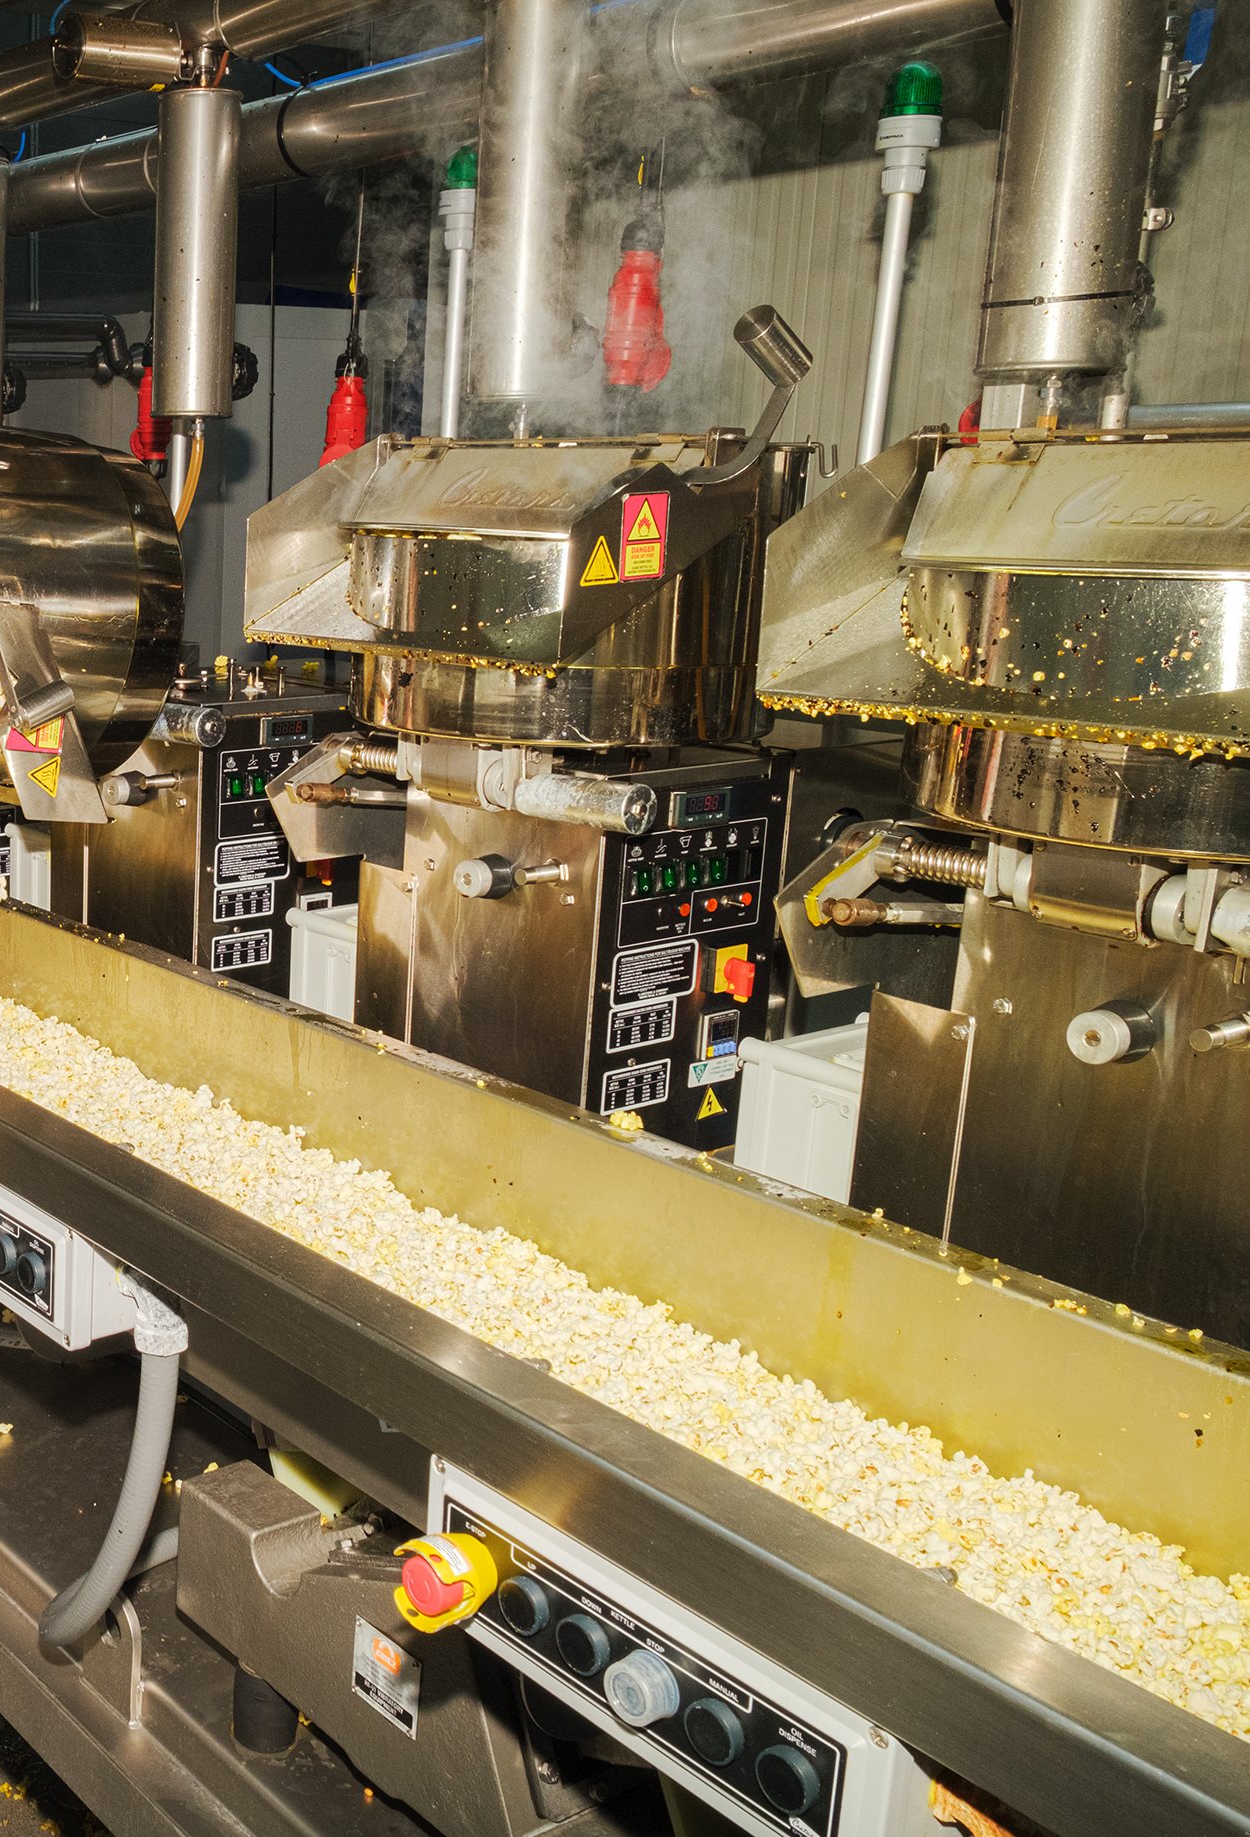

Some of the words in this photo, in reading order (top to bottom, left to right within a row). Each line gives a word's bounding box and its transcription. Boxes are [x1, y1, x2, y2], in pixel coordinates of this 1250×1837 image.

[465, 1521, 487, 1538] E-STOP
[527, 1561, 537, 1570] UP
[581, 1596, 602, 1614] DOWN
[610, 1610, 635, 1630] KETTLE
[646, 1638, 665, 1653] STOP
[709, 1678, 739, 1703] MANUAL
[778, 1727, 817, 1757] DISPENSE
[790, 1727, 804, 1741] OIL
